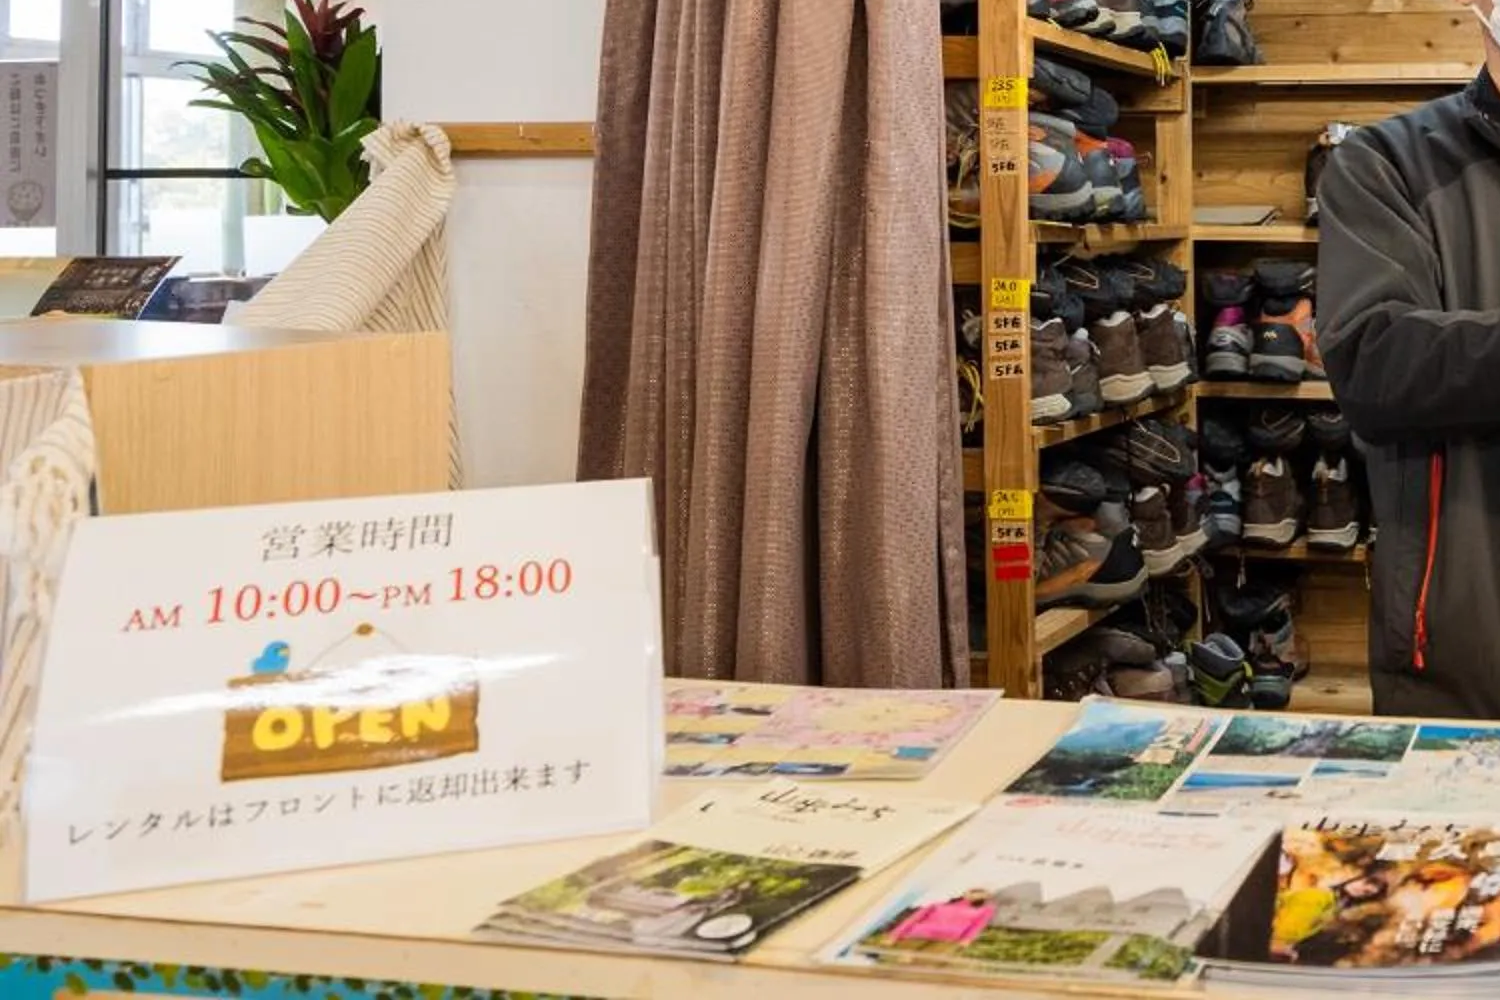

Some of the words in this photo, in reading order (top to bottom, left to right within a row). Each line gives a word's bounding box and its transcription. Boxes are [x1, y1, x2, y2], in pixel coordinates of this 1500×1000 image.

[261, 512, 453, 564] 営業時間
[123, 604, 183, 633] AM
[448, 557, 573, 605] 18:00
[251, 690, 452, 752] OPEN
[67, 757, 594, 850] レンタルはフロントに返却出来ます
